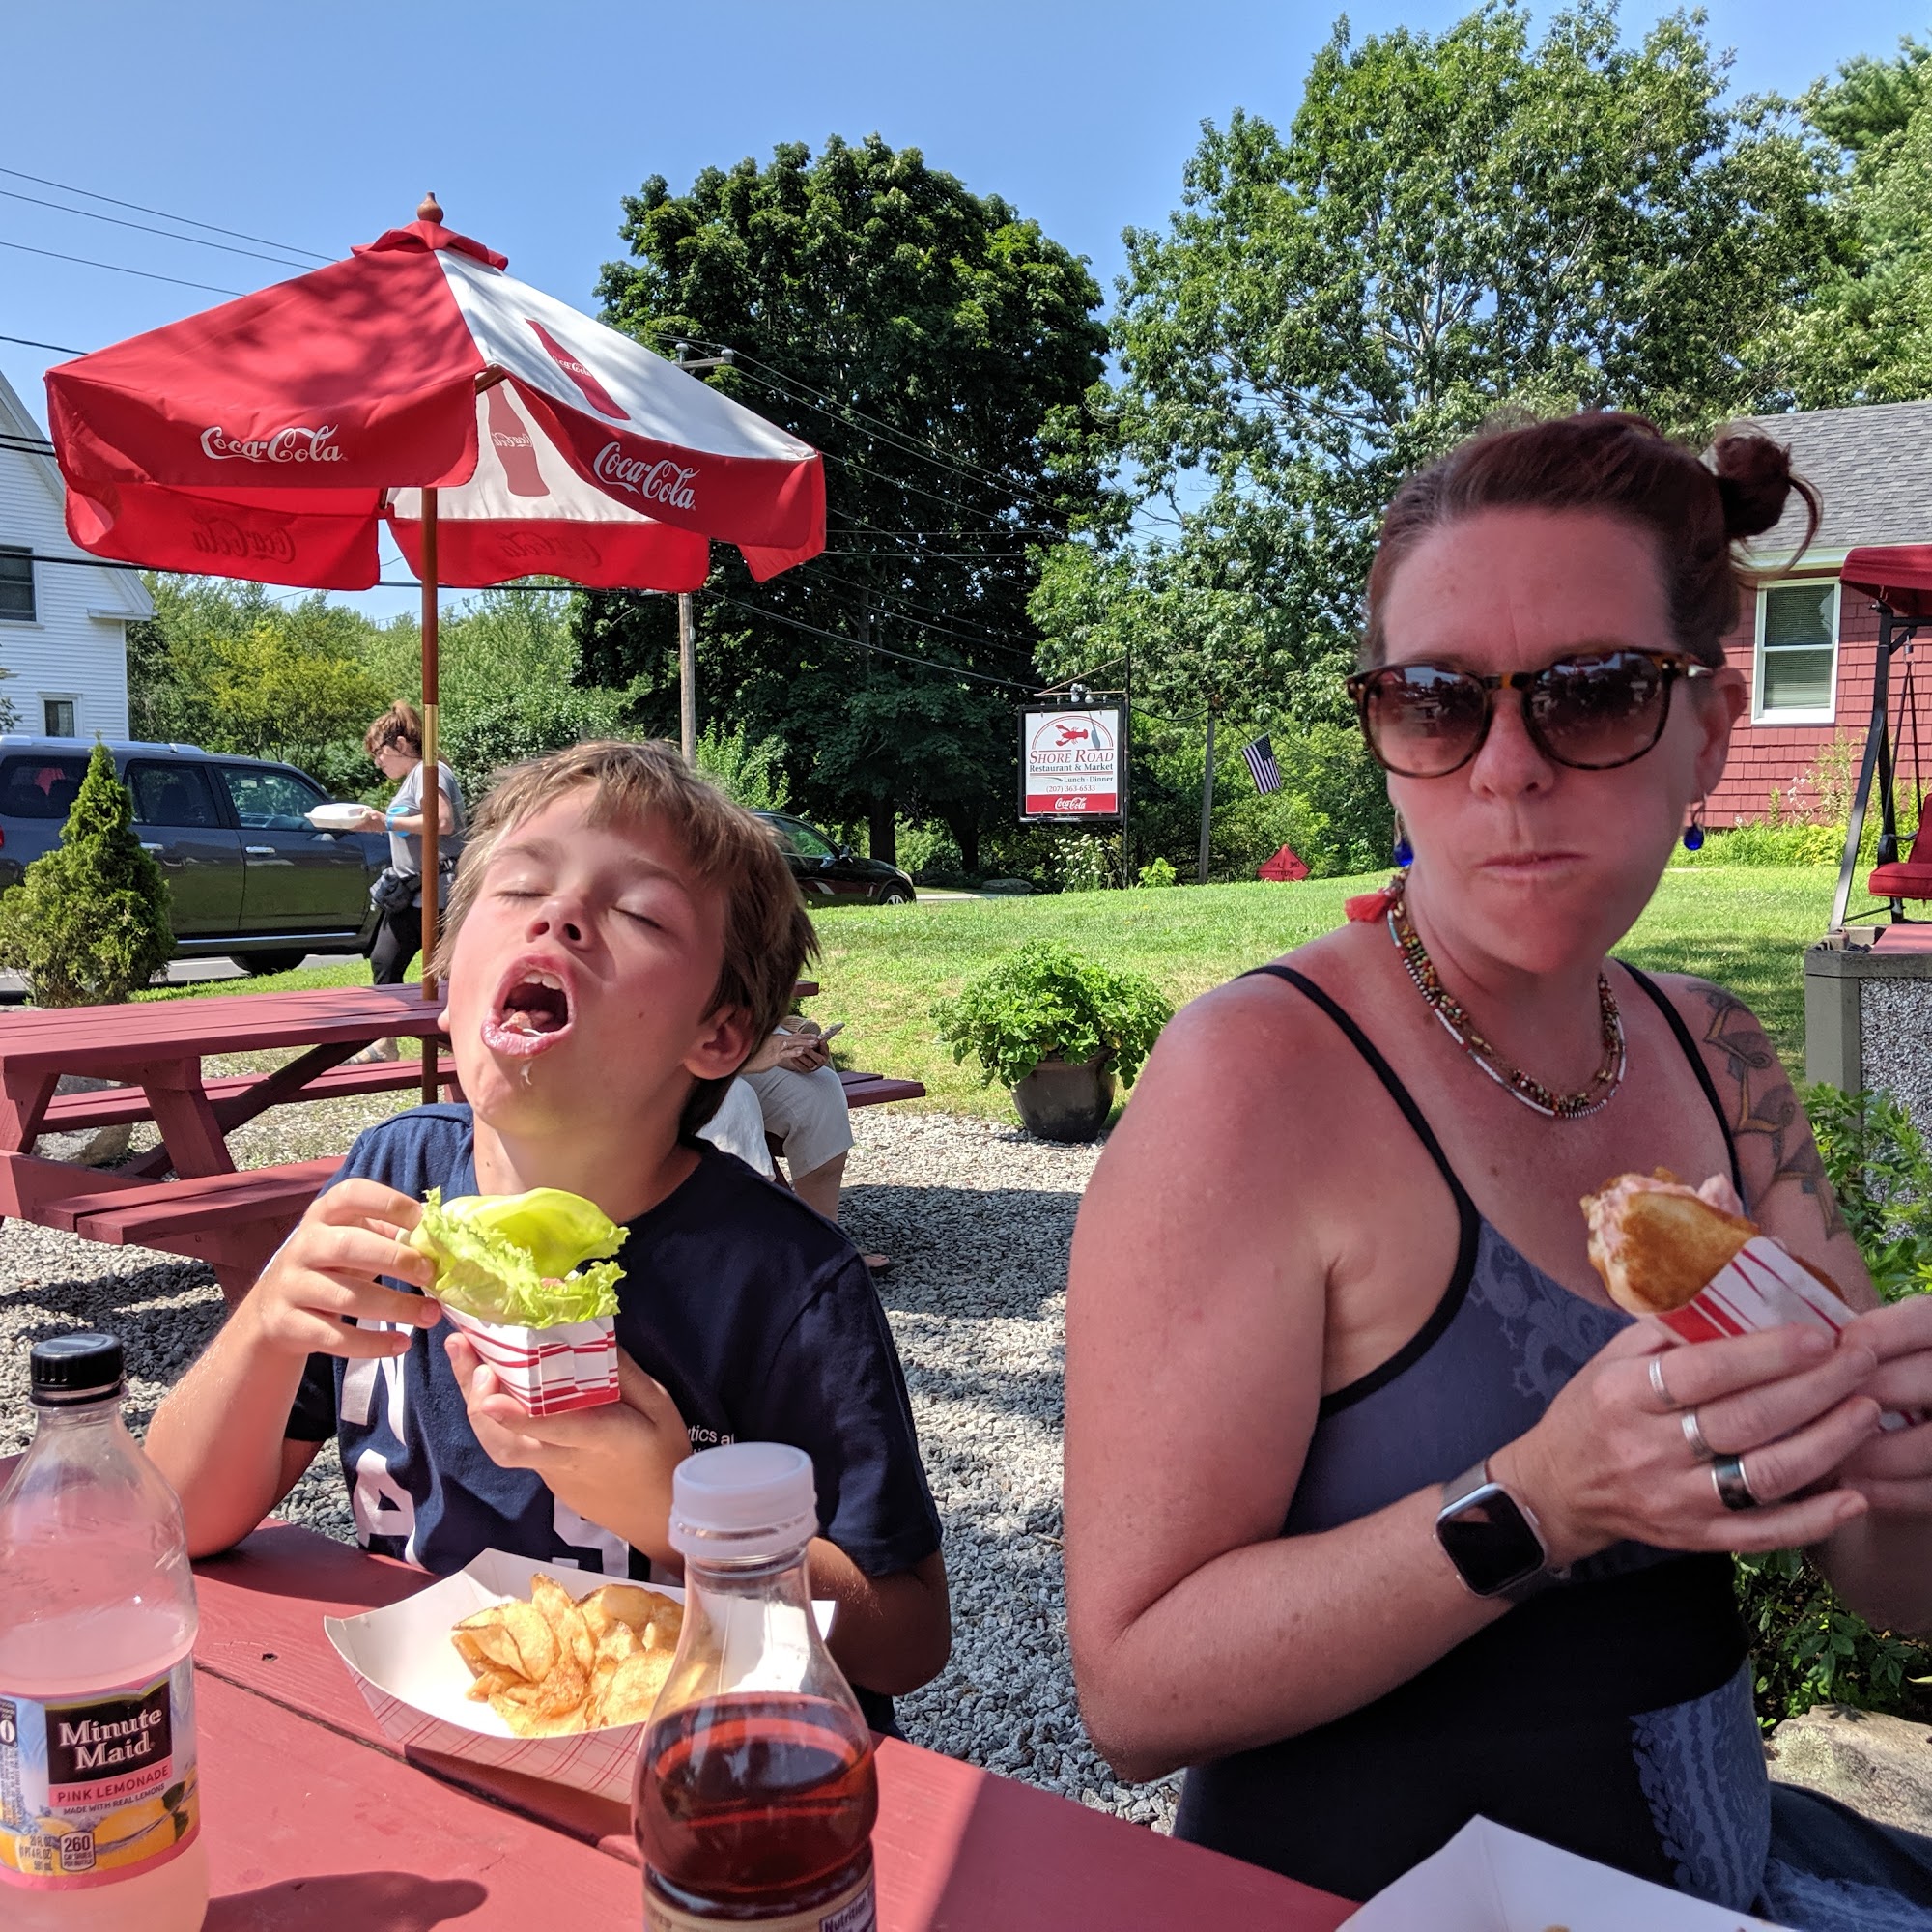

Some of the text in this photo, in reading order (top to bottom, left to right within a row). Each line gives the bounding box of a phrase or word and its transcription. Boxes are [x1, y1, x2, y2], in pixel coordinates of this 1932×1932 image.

[200, 424, 349, 463] Coca-Cola
[593, 441, 701, 511] Coca-Cola
[1029, 750, 1114, 764] SHORE ROAD
[1029, 764, 1072, 773] Restaurant
[1074, 763, 1082, 772] &
[58, 1709, 163, 1747] Minute
[74, 1730, 152, 1770] Maid
[58, 1766, 168, 1803] PINK LEMONADE
[63, 1783, 165, 1815] MADE WITH REAL LEMONS
[64, 1835, 91, 1852] 260
[824, 1896, 867, 1932] Nutrition
